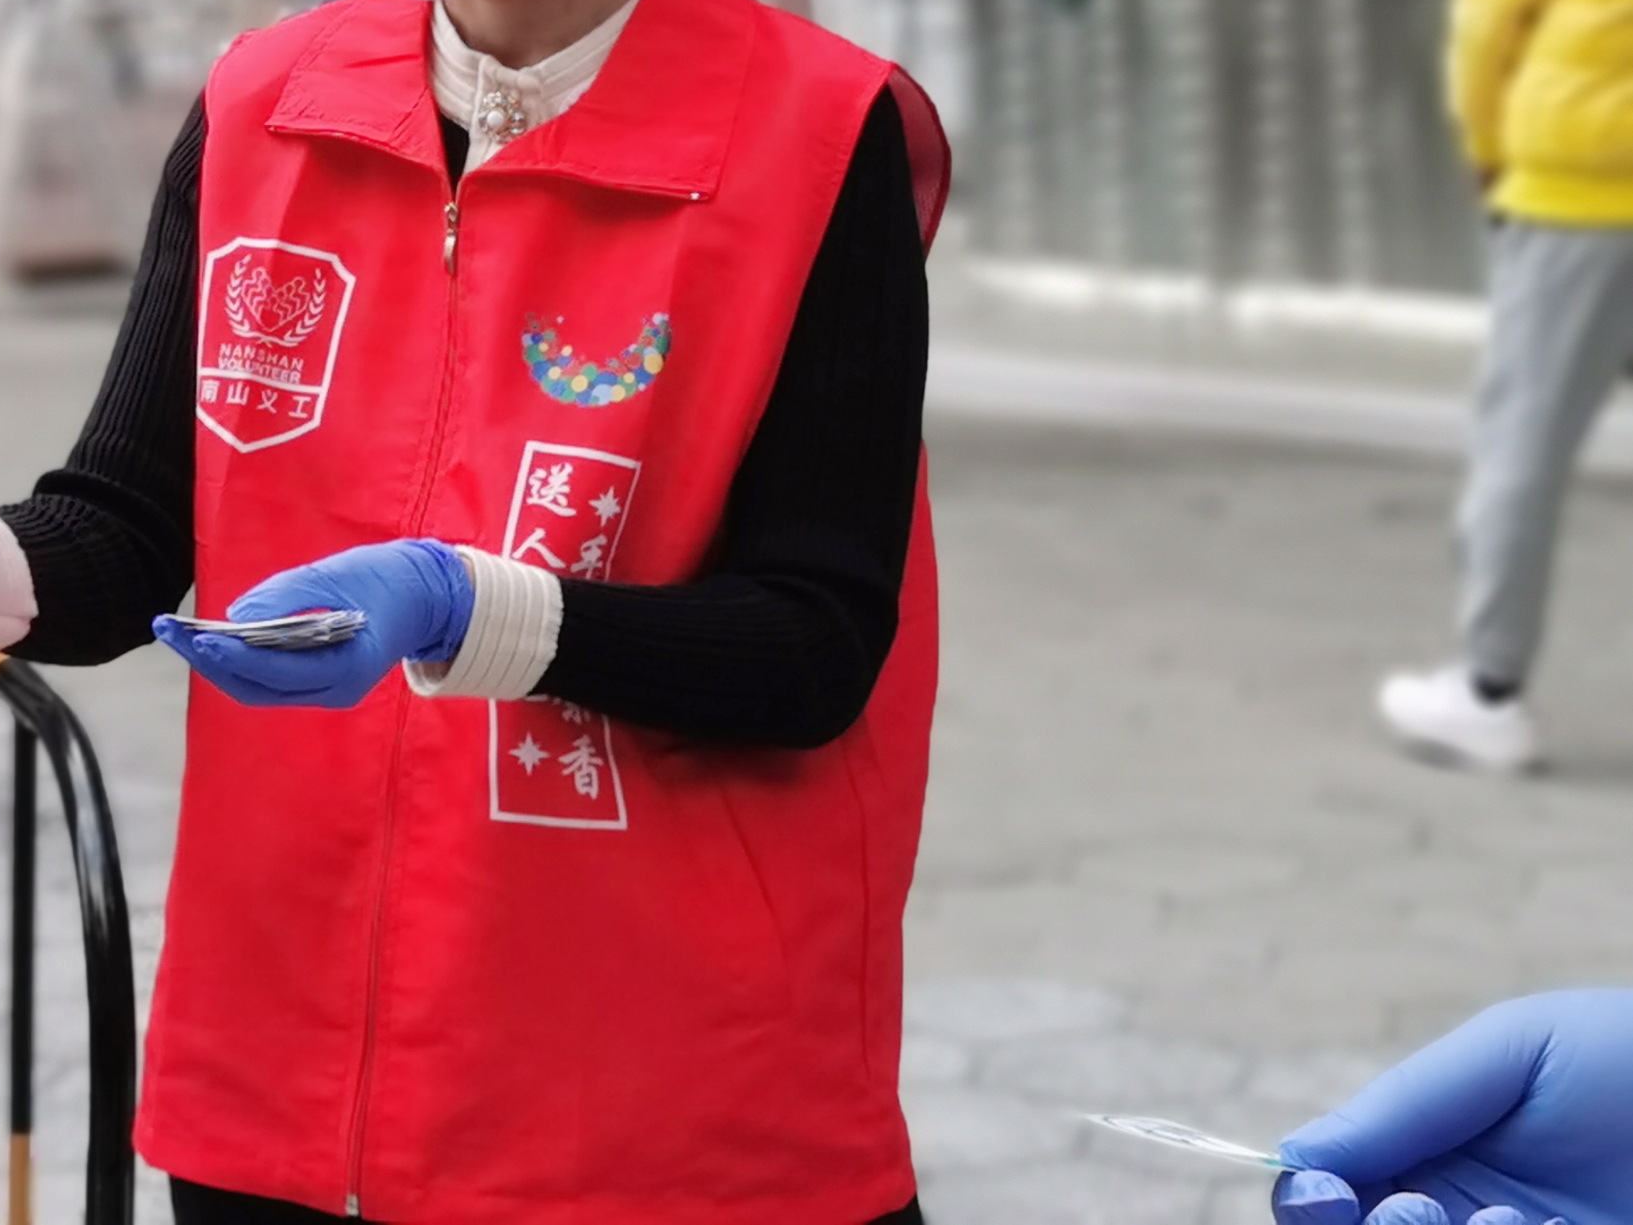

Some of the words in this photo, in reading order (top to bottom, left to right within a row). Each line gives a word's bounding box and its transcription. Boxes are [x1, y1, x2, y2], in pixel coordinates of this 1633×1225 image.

[218, 342, 304, 373] NANSHAN
[200, 379, 312, 419] 南山义工
